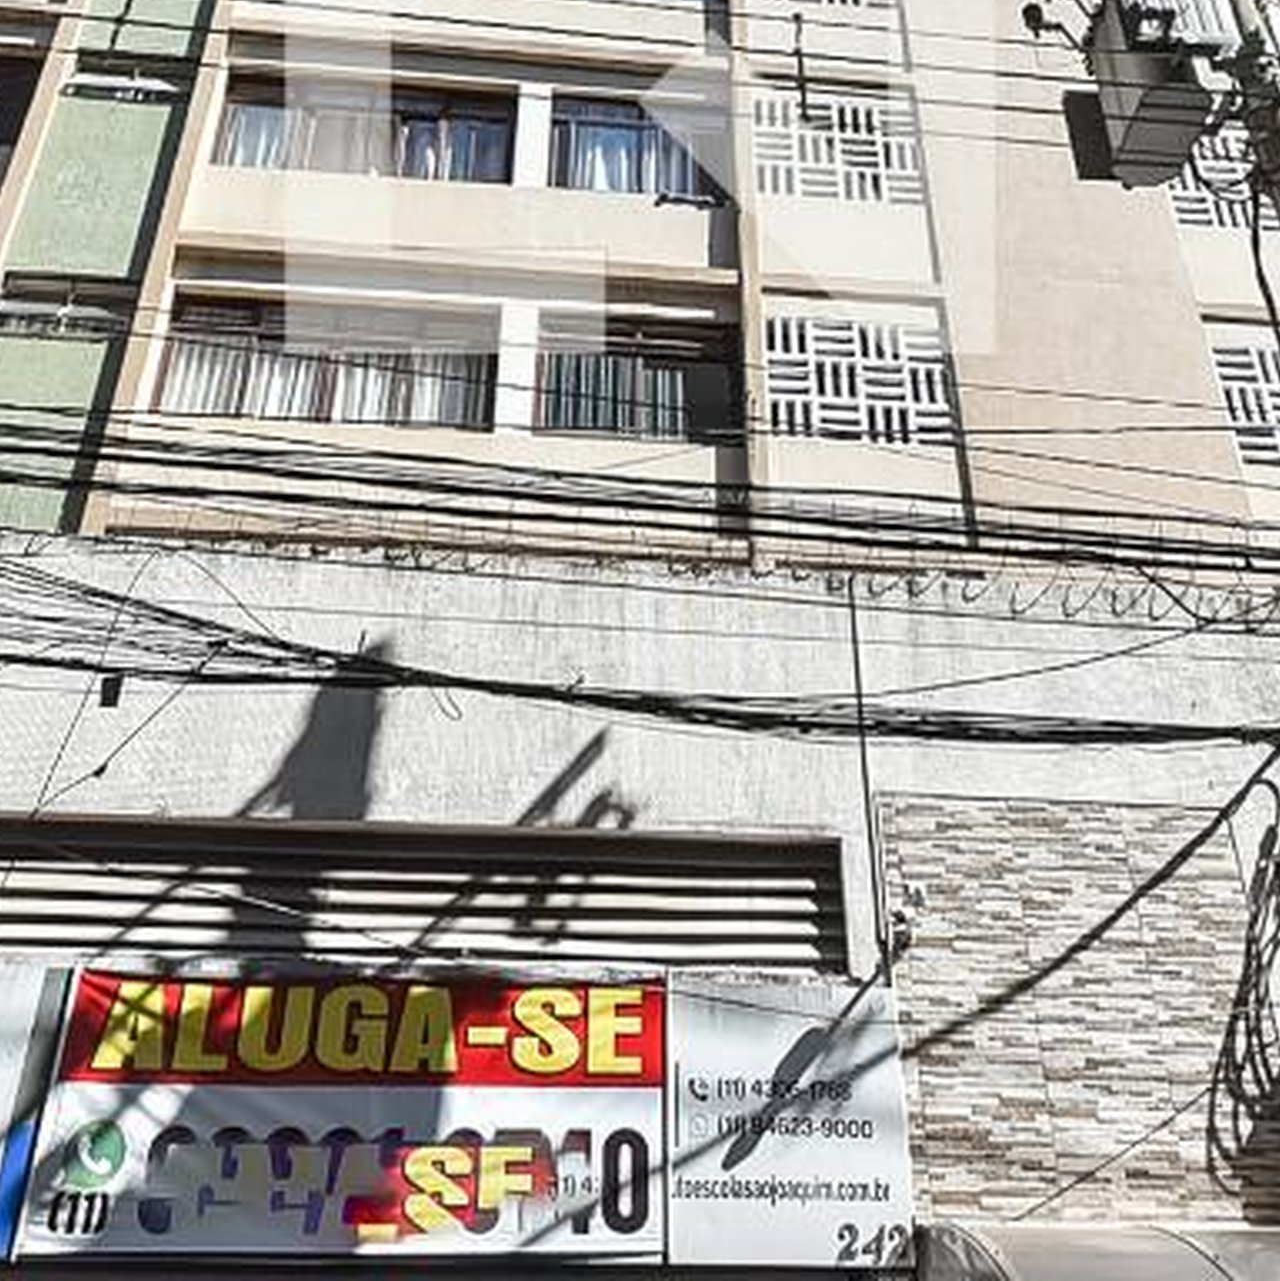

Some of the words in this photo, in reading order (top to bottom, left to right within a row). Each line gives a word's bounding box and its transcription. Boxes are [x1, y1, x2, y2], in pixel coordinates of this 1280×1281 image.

[90, 982, 644, 1075] ALUGA-SE
[717, 1076, 746, 1099] (11)
[47, 1191, 107, 1234] (11)
